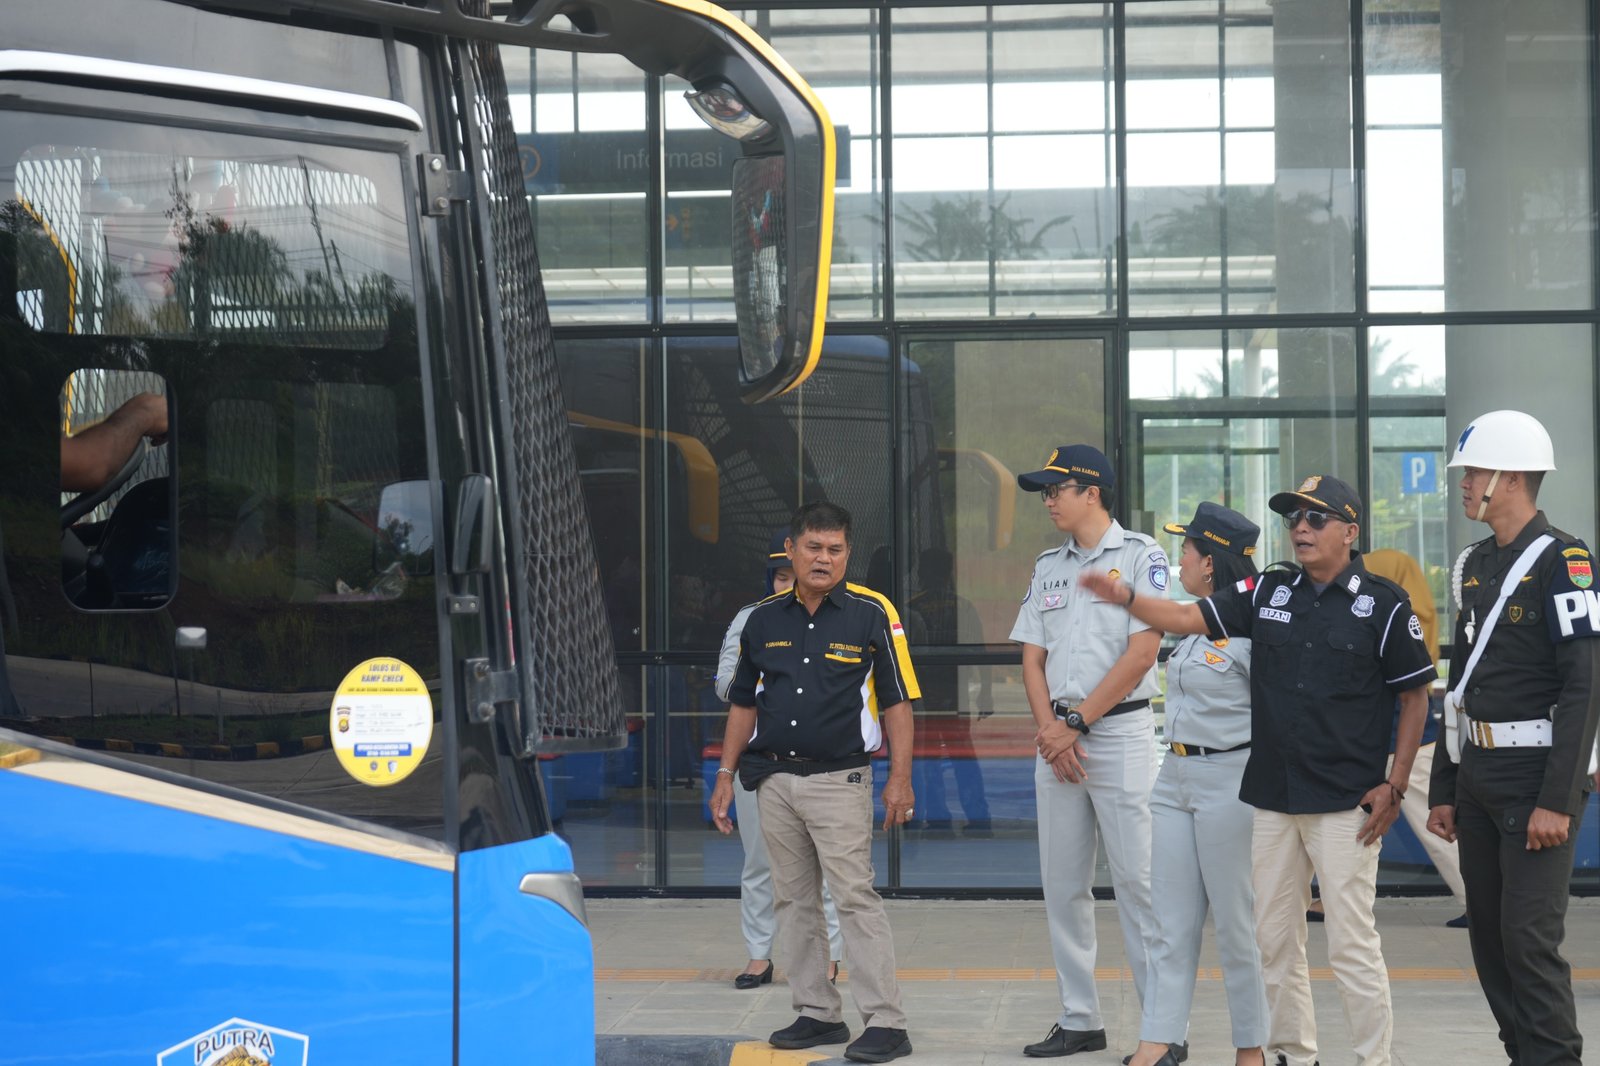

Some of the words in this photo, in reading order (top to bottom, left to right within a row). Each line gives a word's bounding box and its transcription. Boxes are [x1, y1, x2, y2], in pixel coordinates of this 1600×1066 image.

[617, 147, 723, 169] Infmasi
[1411, 457, 1426, 489] P
[1043, 579, 1068, 590] LIAN
[195, 1028, 274, 1064] PUTRA
